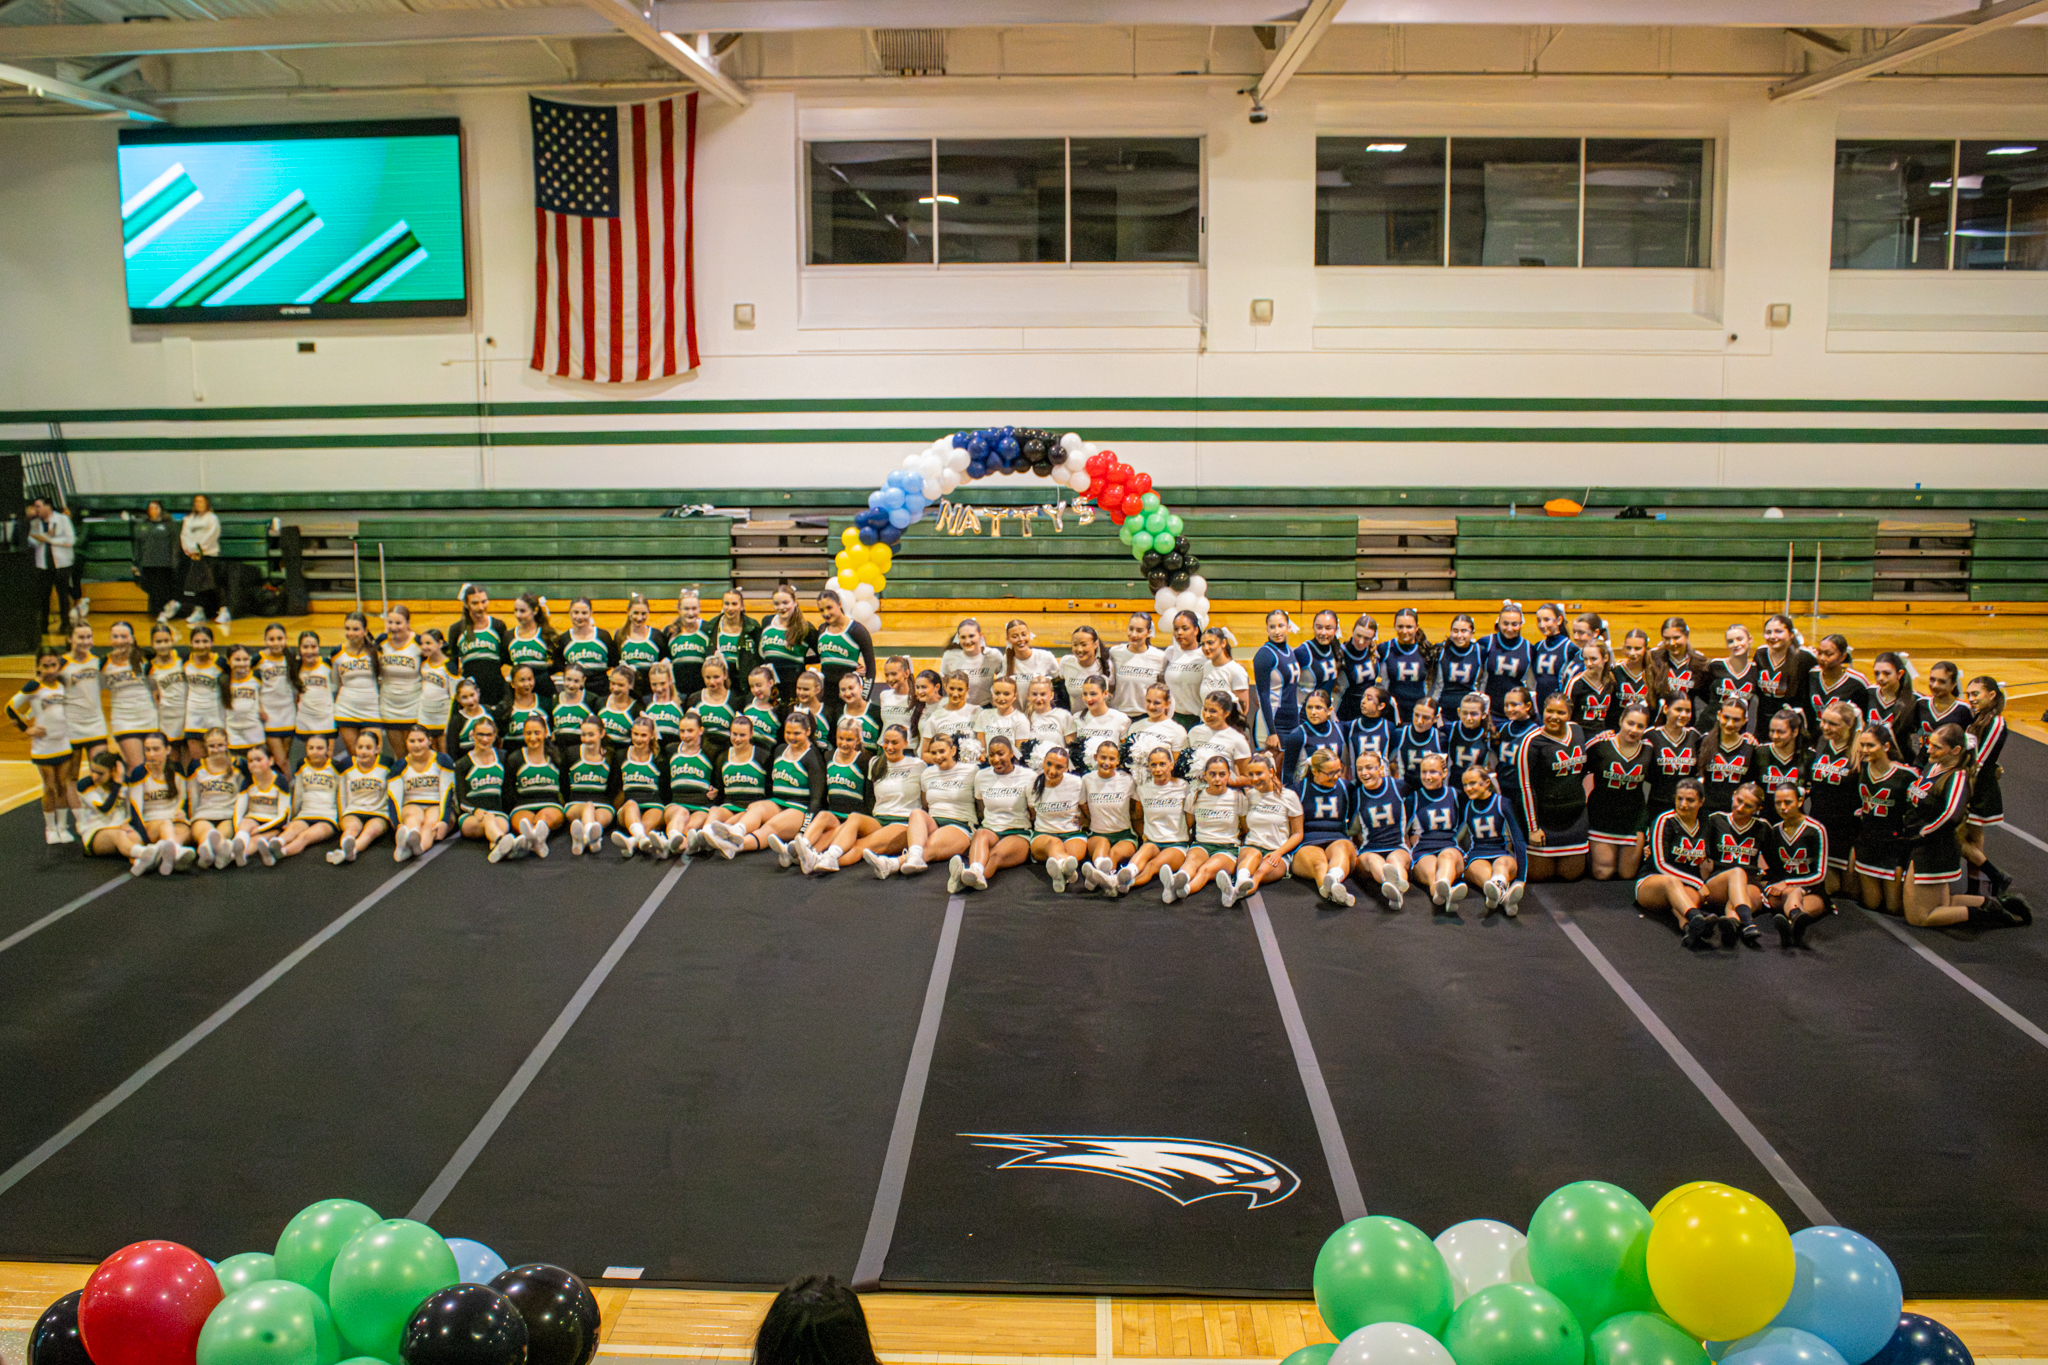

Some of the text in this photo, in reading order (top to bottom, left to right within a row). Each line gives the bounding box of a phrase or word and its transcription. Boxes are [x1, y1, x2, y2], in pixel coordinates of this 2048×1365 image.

[935, 496, 1096, 537] NATTYS
[511, 646, 543, 661] Gators
[568, 648, 602, 663] Gators
[621, 649, 655, 661] Gators
[671, 641, 705, 656] Gators
[817, 642, 849, 657] Gators
[1287, 661, 1300, 684] H
[1320, 659, 1338, 682] H
[1354, 660, 1376, 684] H
[1397, 661, 1420, 682] H
[1449, 662, 1472, 683] H
[1495, 655, 1520, 678] H
[1536, 653, 1557, 675] H
[701, 712, 730, 728] ators
[1455, 746, 1480, 768] H
[1500, 742, 1519, 765] H
[671, 763, 705, 778] Gators
[723, 772, 758, 786] Gators
[772, 768, 799, 787] Gators
[1089, 792, 1123, 801] WAGNER
[1314, 796, 1339, 819] H
[1368, 803, 1395, 828] H
[1426, 808, 1452, 831] H
[1472, 815, 1498, 839] H
